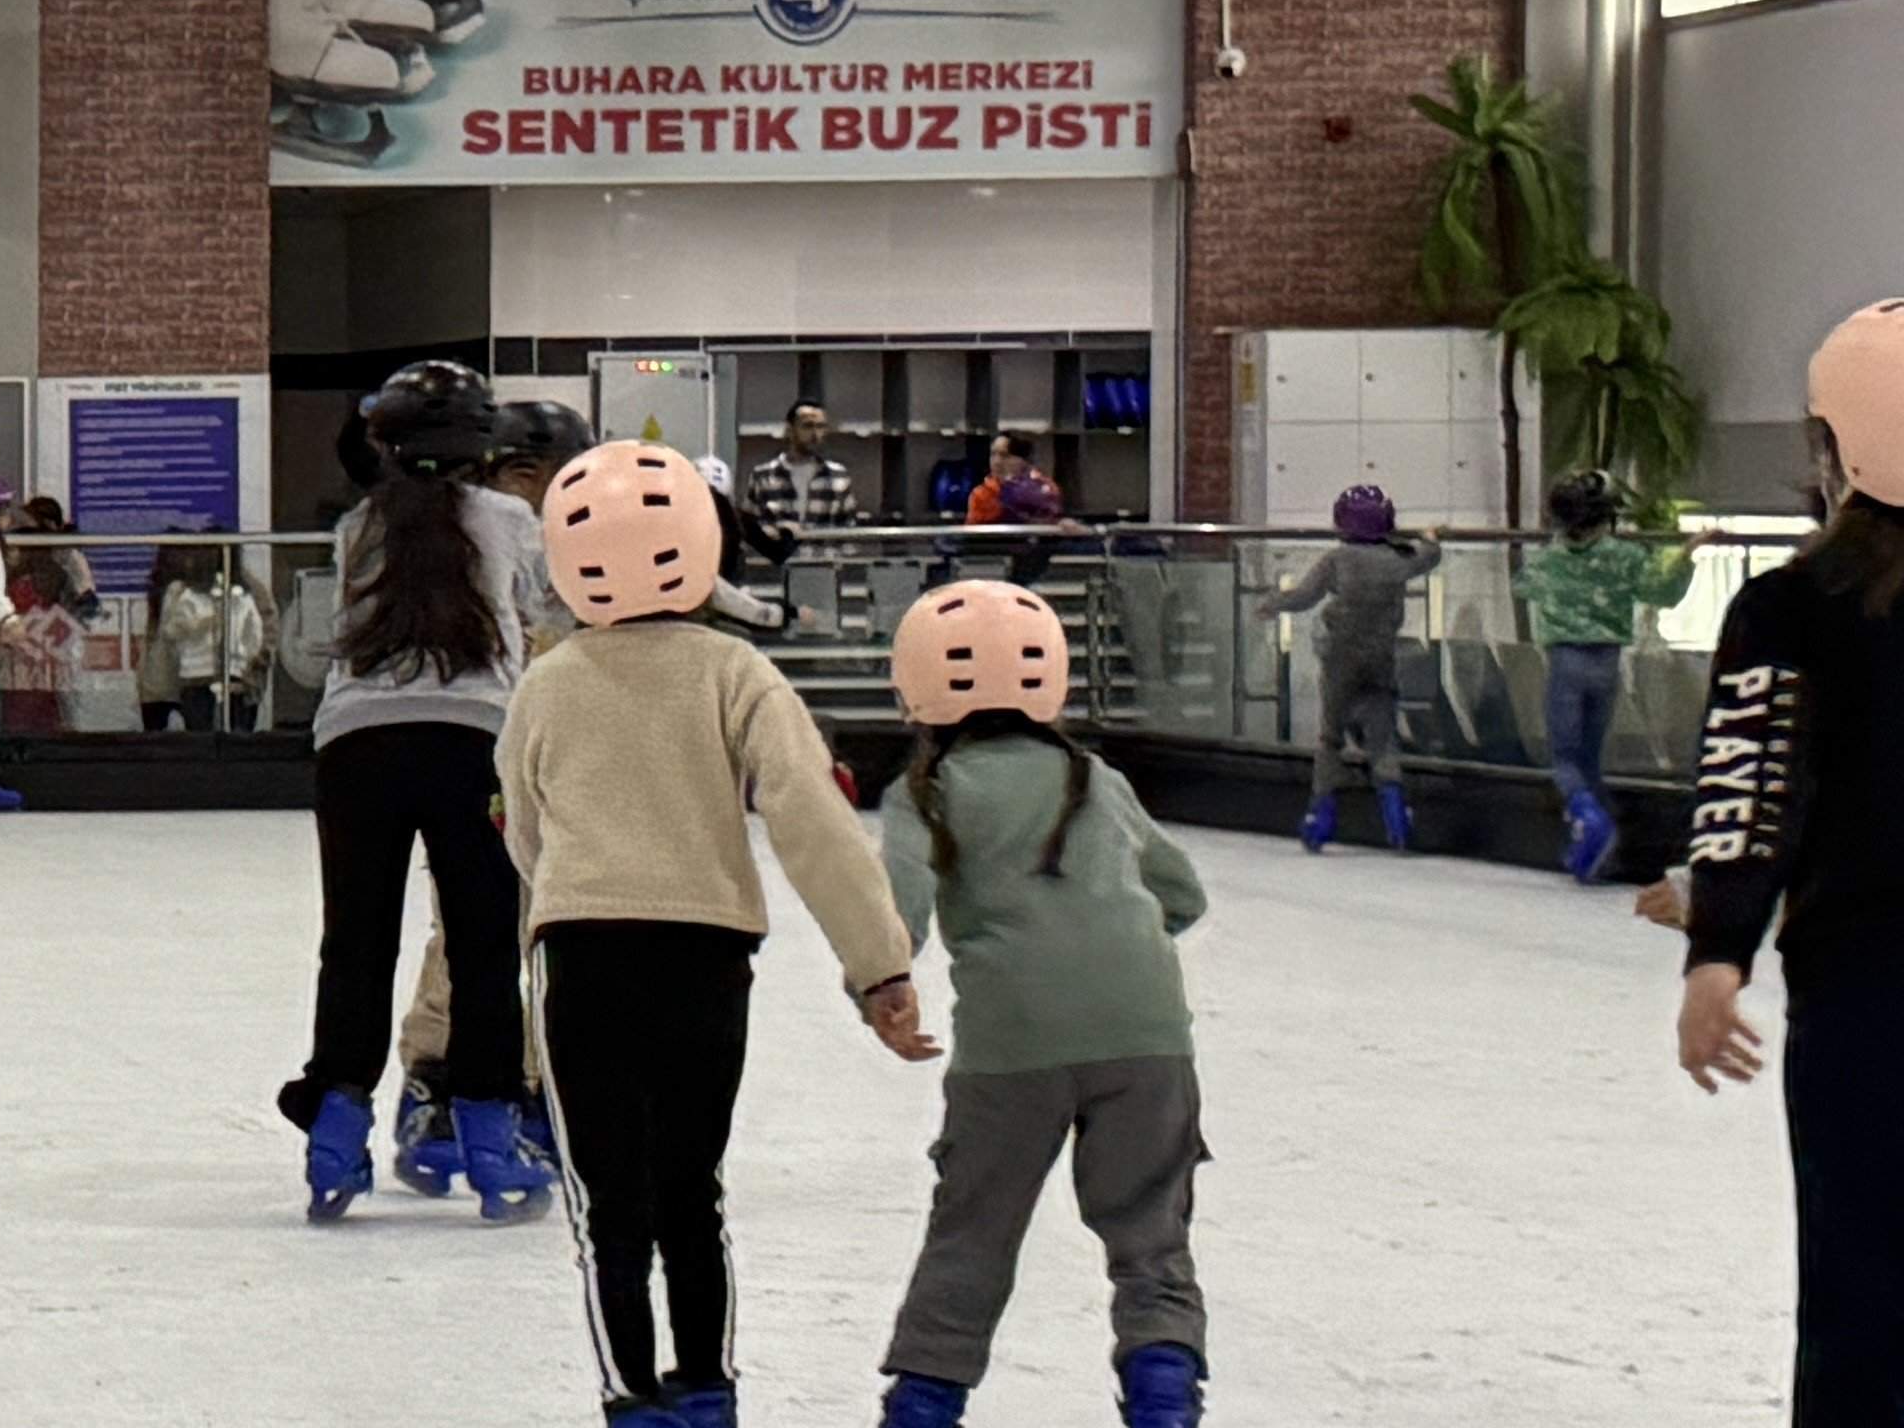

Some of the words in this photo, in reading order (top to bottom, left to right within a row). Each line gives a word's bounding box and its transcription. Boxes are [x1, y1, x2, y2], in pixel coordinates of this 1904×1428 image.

[522, 66, 707, 96] BUHARA
[720, 63, 889, 93] KÜLTÜR
[902, 59, 1094, 92] MERKEZİ
[461, 104, 799, 155] SENTETİK
[821, 105, 959, 151] BUZ
[982, 101, 1152, 149] PİSTİ
[1688, 665, 1774, 863] PLAYER
